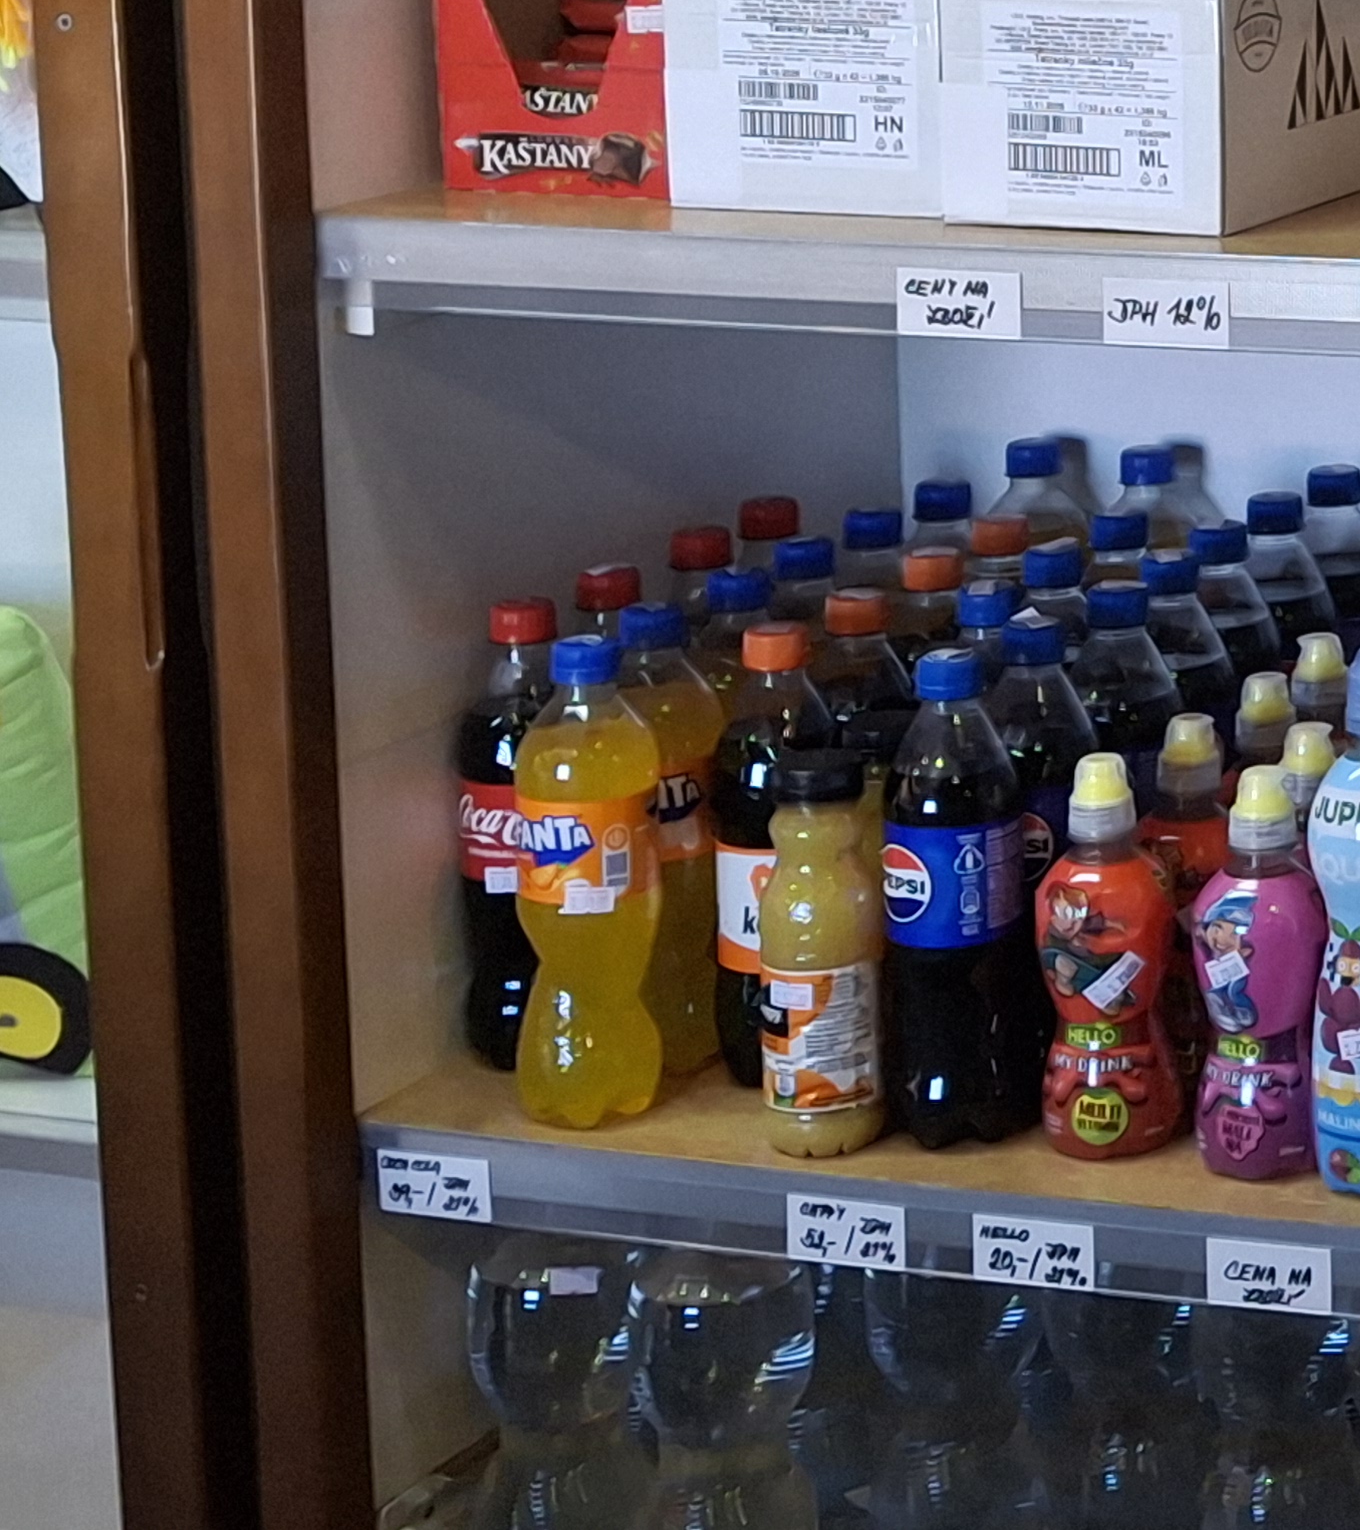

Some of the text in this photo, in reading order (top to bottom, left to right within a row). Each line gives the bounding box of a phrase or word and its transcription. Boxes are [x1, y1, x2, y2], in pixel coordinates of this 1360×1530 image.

[873, 114, 905, 134] HN
[479, 136, 595, 174] KAŠTANY
[1138, 149, 1170, 169] ML
[903, 278, 990, 299] CENY NA
[1107, 294, 1222, 331] DPH 12%
[1067, 1026, 1117, 1045] HELLO
